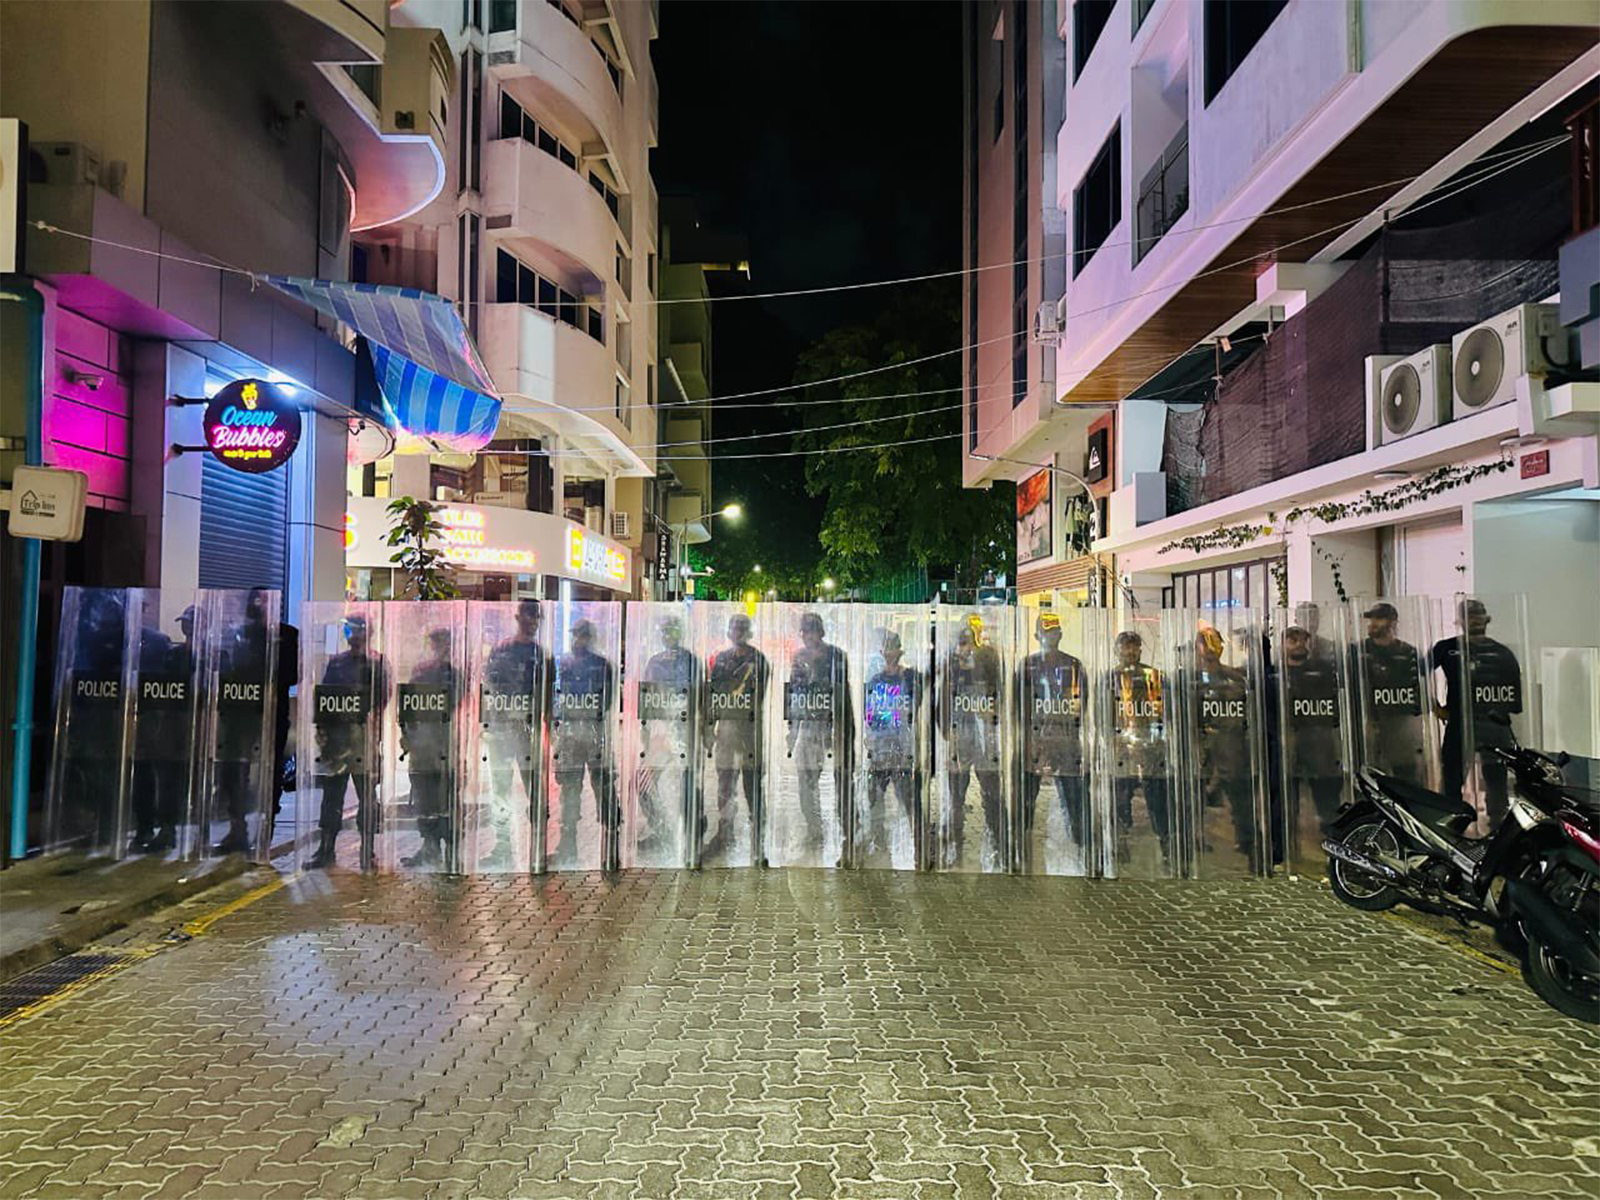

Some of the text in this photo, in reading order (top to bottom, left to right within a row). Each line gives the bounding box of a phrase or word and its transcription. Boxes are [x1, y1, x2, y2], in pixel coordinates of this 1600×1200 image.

[221, 405, 278, 426] Ocean
[213, 426, 286, 448] Bubbles
[77, 680, 118, 698] POLICE
[143, 682, 185, 699] POLICE
[223, 683, 260, 701] POLICE
[1374, 687, 1415, 705] POLICE
[1475, 686, 1515, 702] POLICE
[319, 696, 360, 712] POLICE
[402, 694, 445, 711] POLICE
[486, 694, 530, 711] POLICE
[559, 693, 600, 709] POLICE
[644, 693, 687, 709] POLICE
[711, 693, 751, 710] POLICE
[790, 693, 830, 710] POLICE
[954, 695, 994, 712] POLICE
[1035, 699, 1075, 715] POLICE
[1118, 701, 1159, 717] POLICE
[1203, 701, 1244, 717] POLICE
[1293, 699, 1334, 716] POLICE
